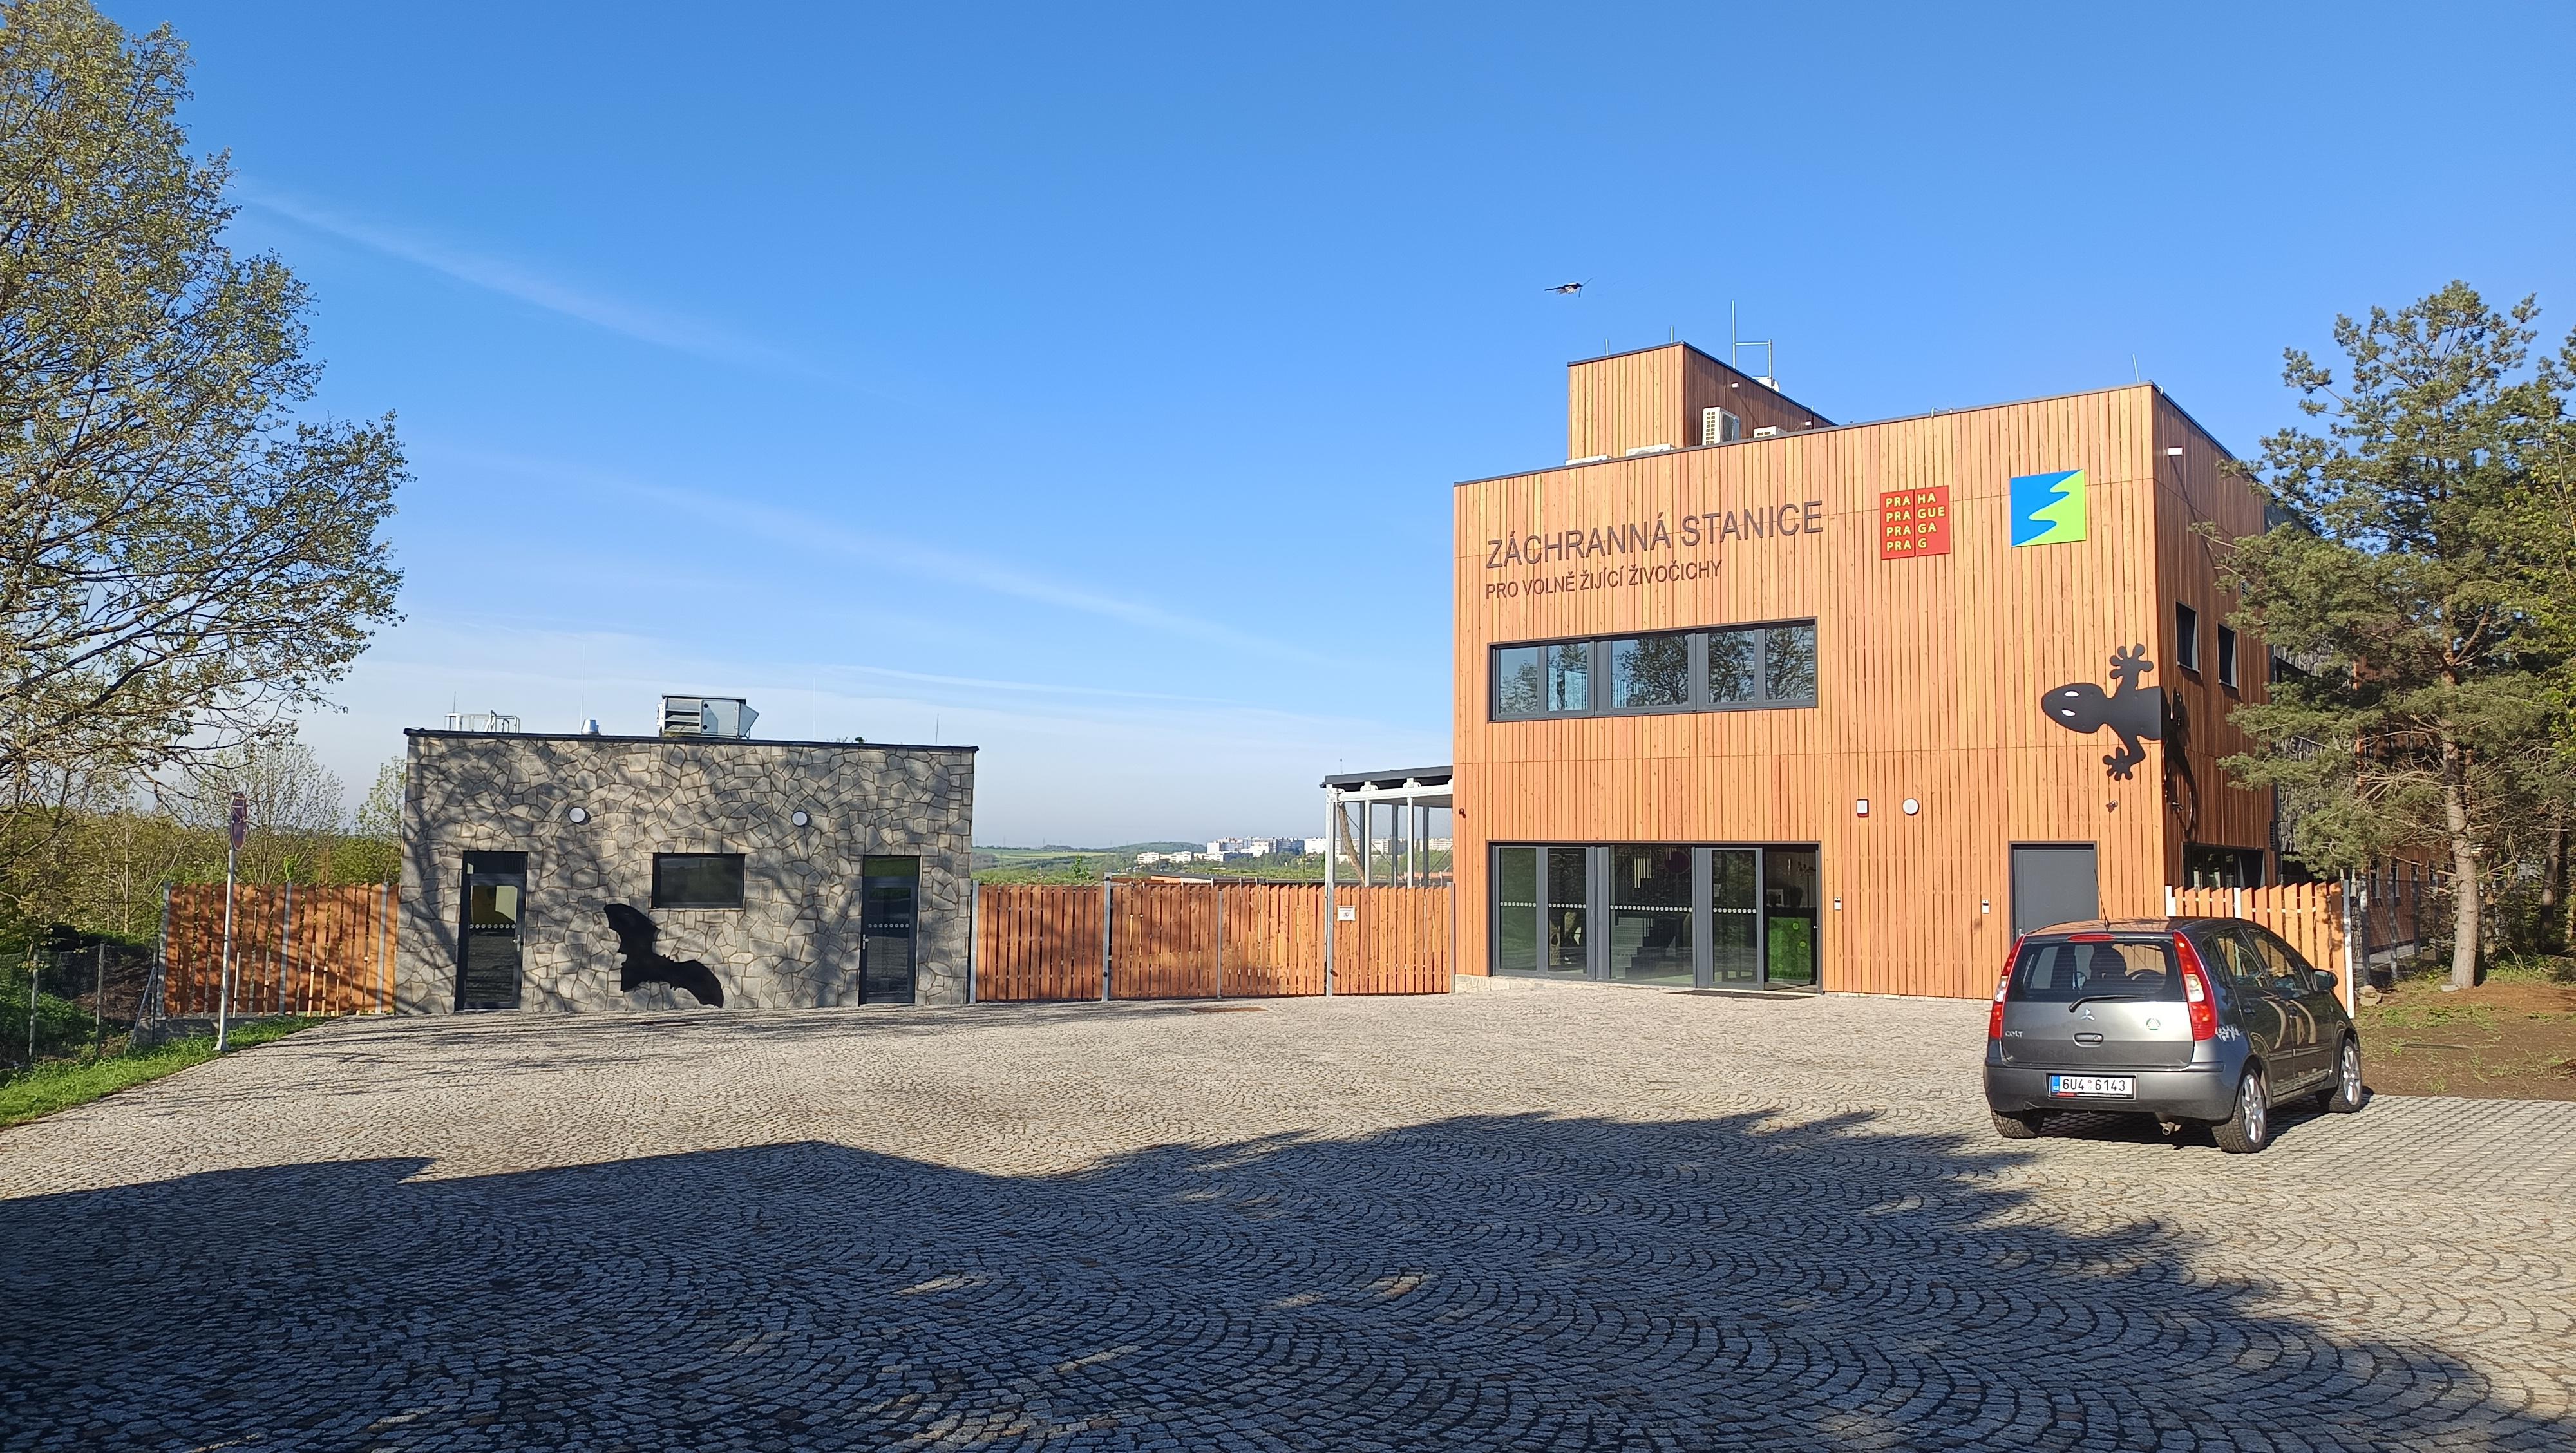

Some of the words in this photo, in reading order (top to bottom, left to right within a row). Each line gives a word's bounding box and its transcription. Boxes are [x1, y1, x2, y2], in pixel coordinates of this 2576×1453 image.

[1886, 495, 1911, 508] PRA
[1917, 493, 1936, 504] HA
[1886, 510, 1911, 522] PRA
[1917, 506, 1945, 518] GUE
[1486, 512, 1672, 569] ZÁCHRANNÁ
[1681, 500, 1824, 546] STANICE
[1886, 525, 1911, 537] PRA
[1917, 522, 1937, 534] GA
[1886, 540, 1911, 552] PRA
[1918, 538, 1927, 548] G
[1486, 581, 1519, 600] PRO
[1522, 571, 1575, 596] VOLNĚ
[1580, 565, 1624, 591] ŽIJÍCÍ
[1628, 559, 1723, 585] ŽIVOČICHY
[2063, 1078, 2085, 1090] 6U4
[2094, 1079, 2125, 1092] 6143
